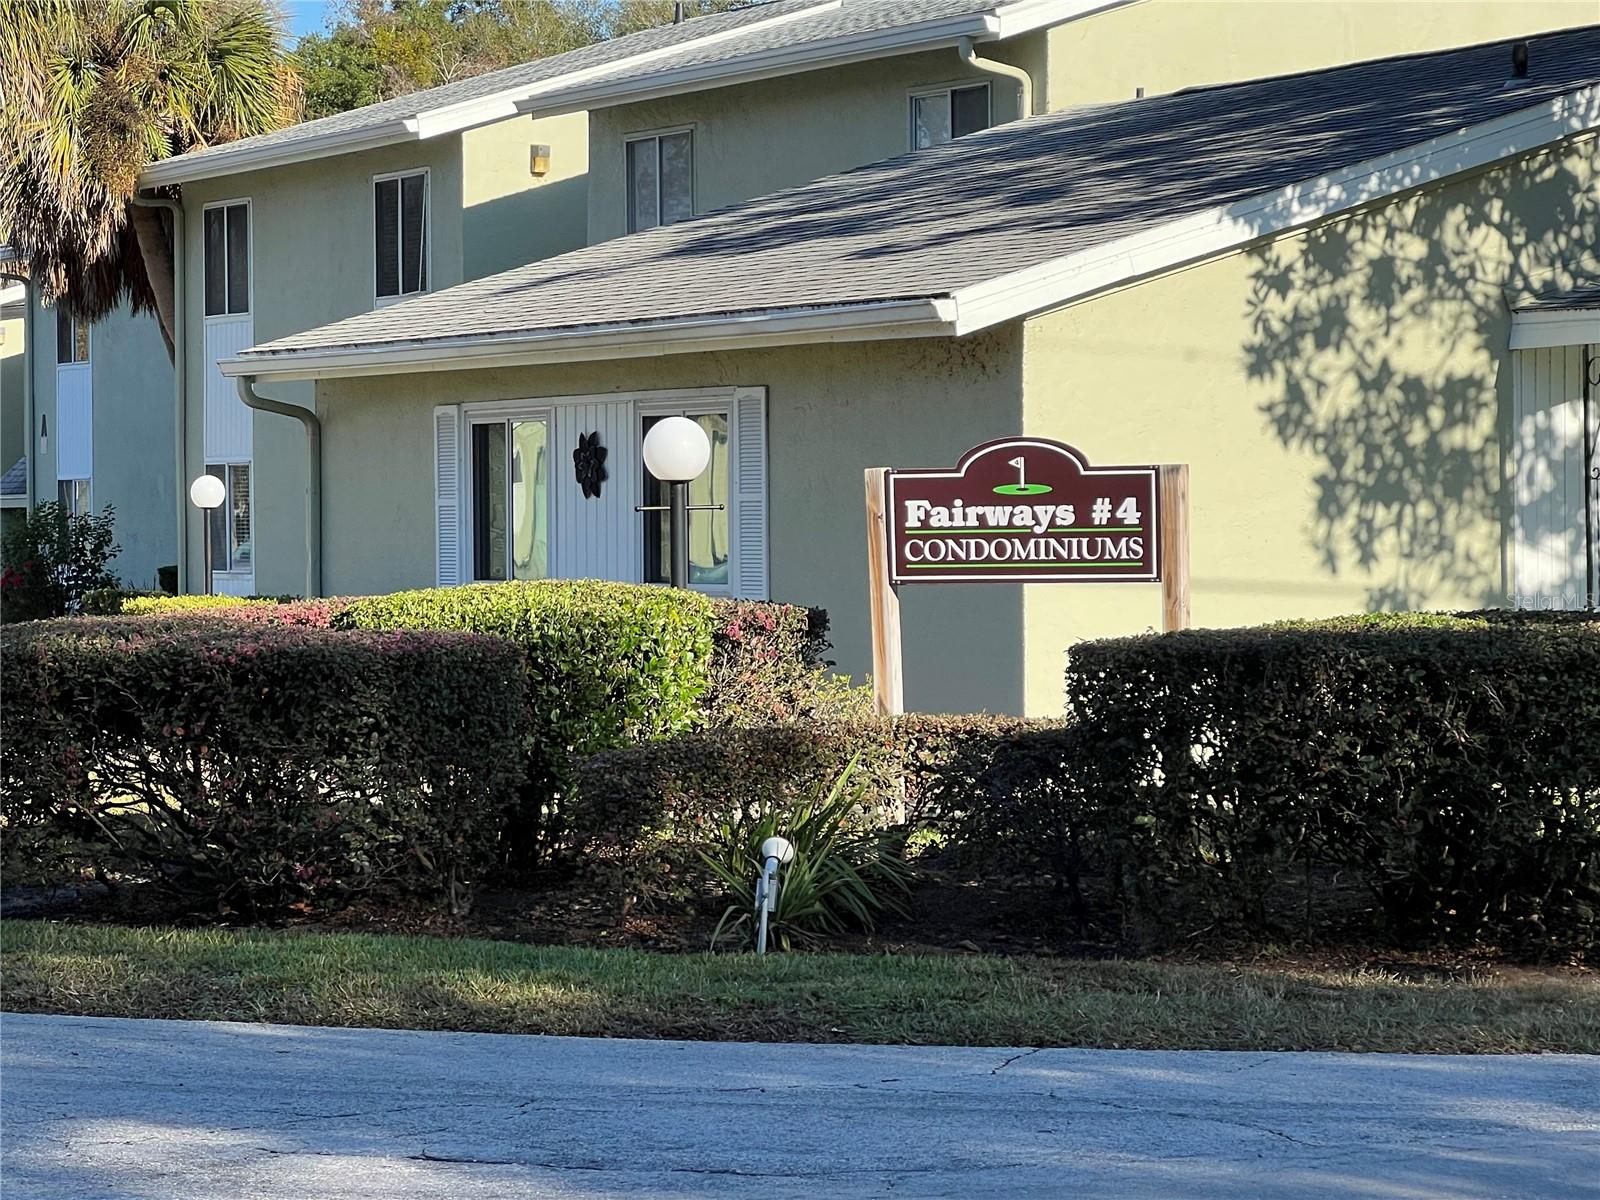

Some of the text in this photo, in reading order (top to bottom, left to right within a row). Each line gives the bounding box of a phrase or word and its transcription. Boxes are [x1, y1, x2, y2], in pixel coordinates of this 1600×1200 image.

[904, 497, 1142, 534] Fairways #4
[904, 536, 1144, 562] CONDOMINIUMS
